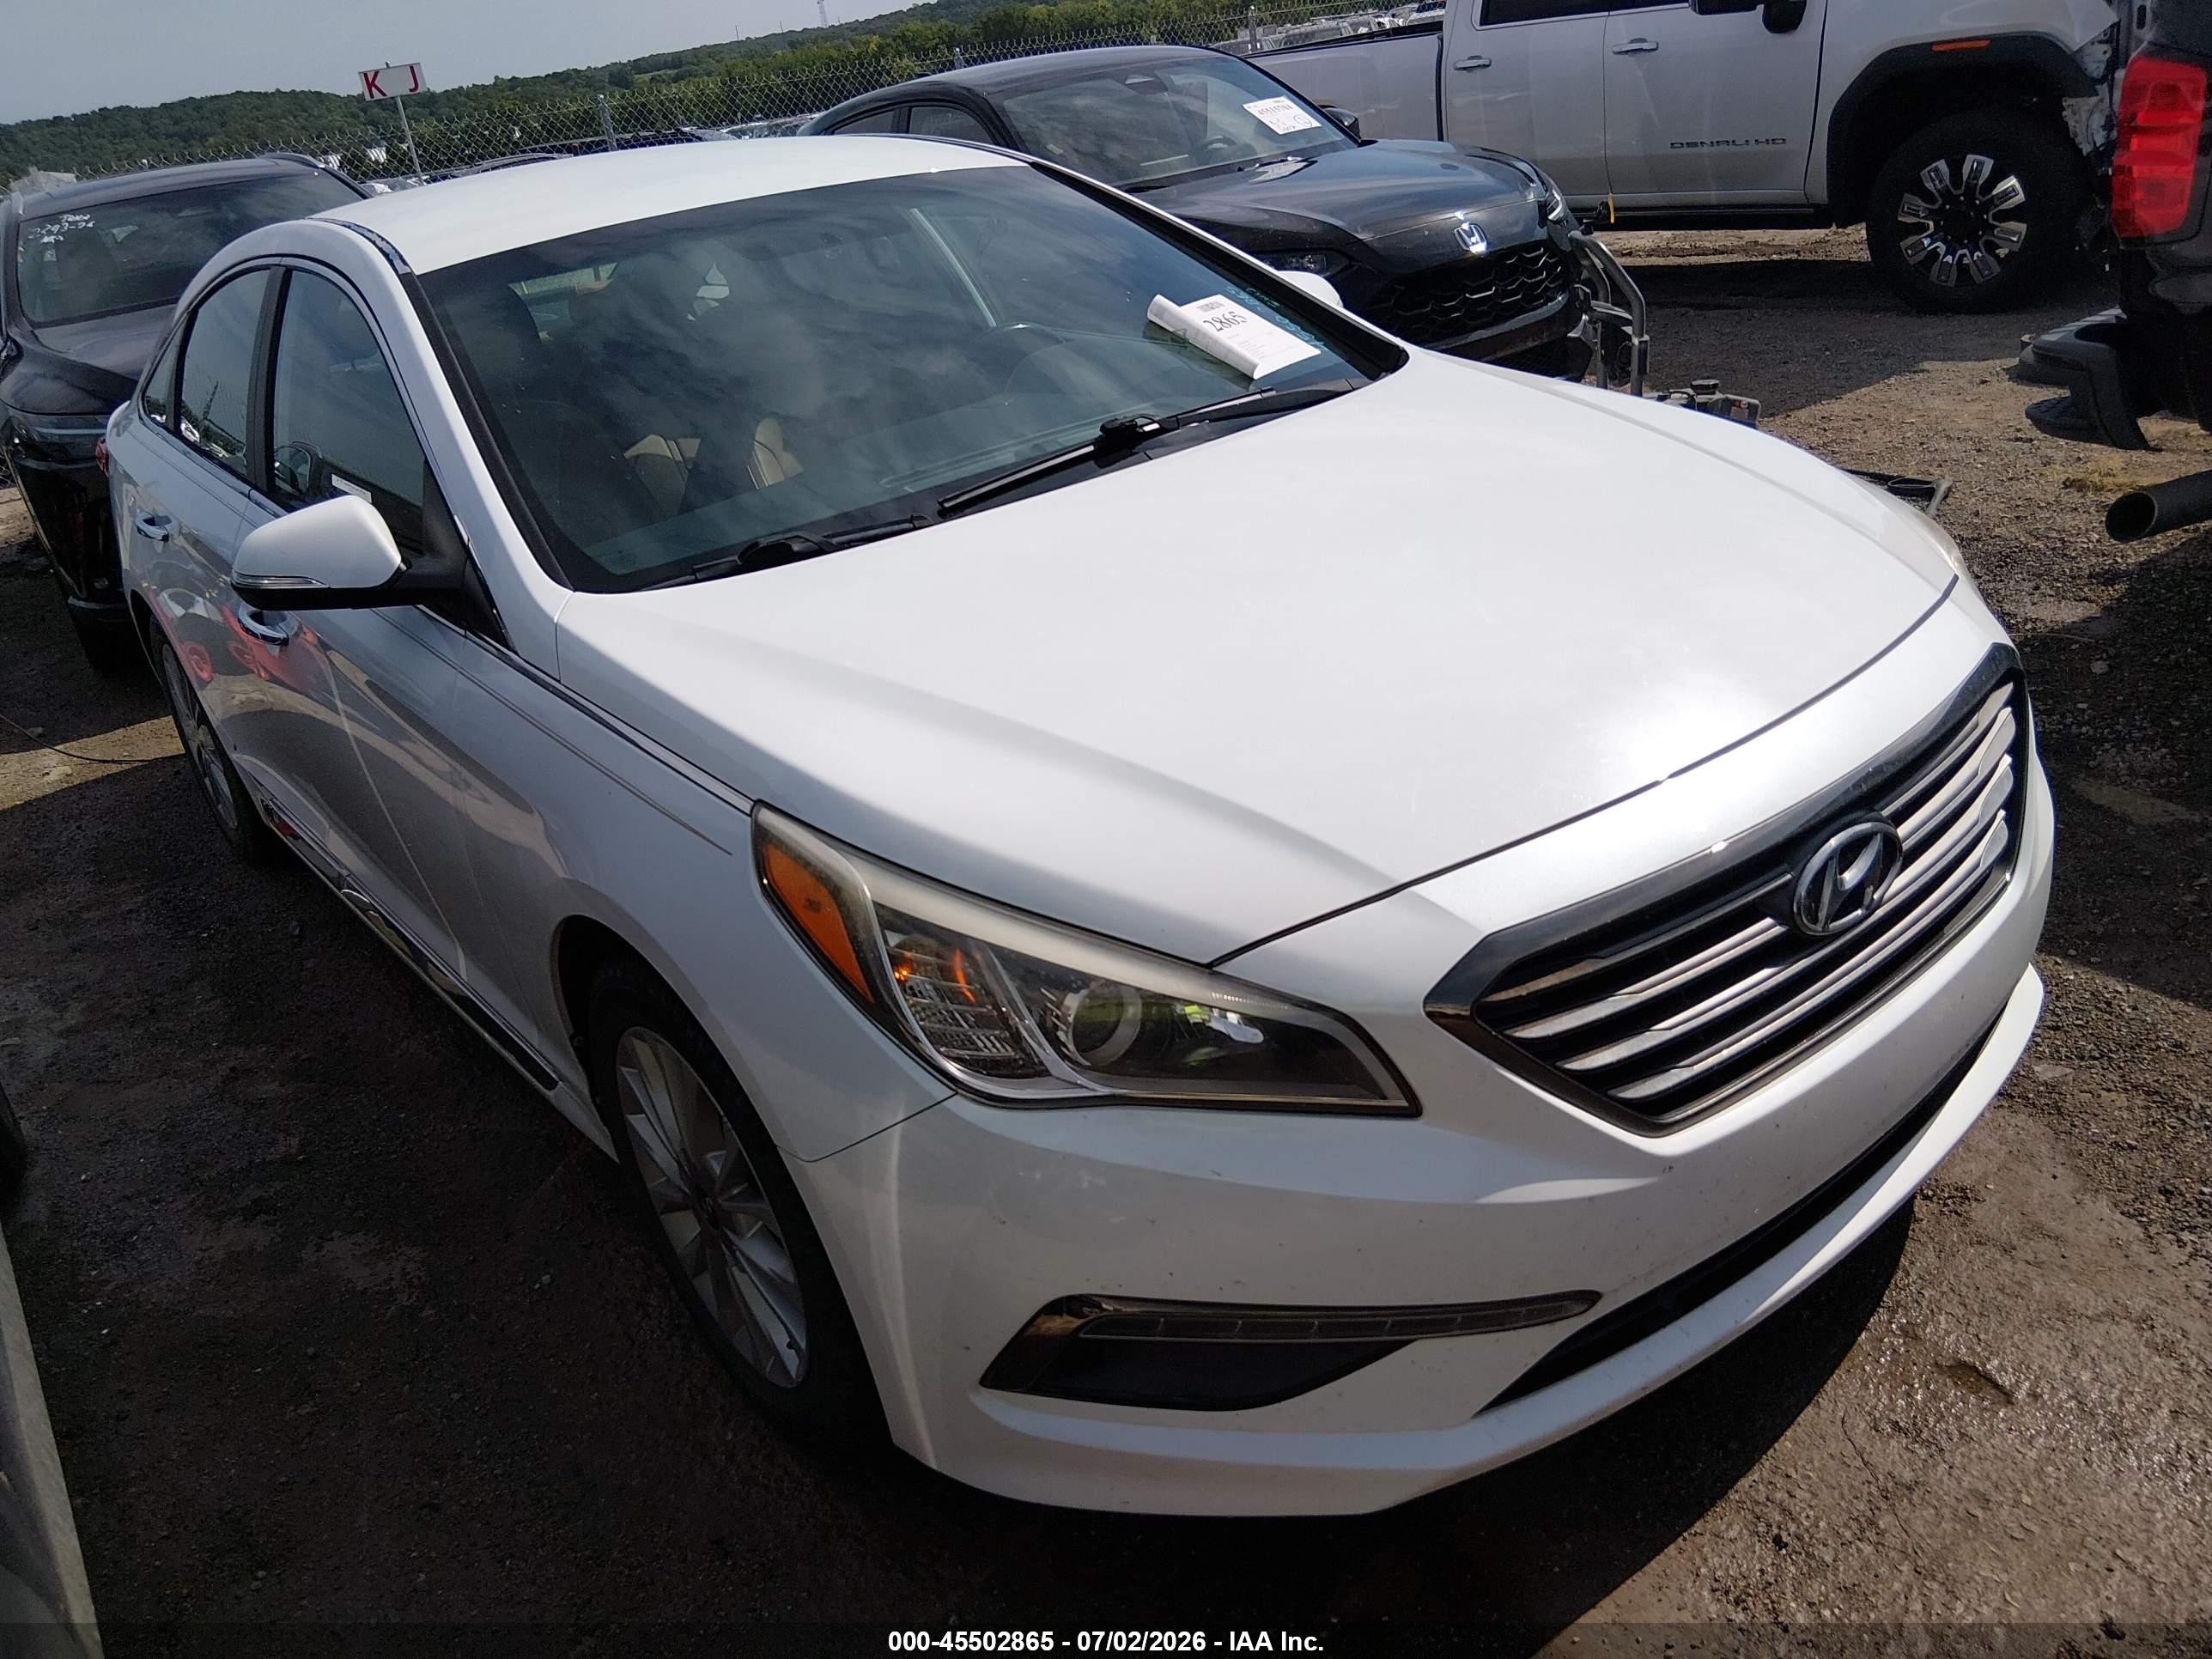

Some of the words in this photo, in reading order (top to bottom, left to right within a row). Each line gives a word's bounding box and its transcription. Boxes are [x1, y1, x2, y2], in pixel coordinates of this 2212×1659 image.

[363, 70, 387, 99] K
[408, 65, 419, 92] J
[1670, 139, 1749, 149] DENALI
[1203, 311, 1248, 331] 2865
